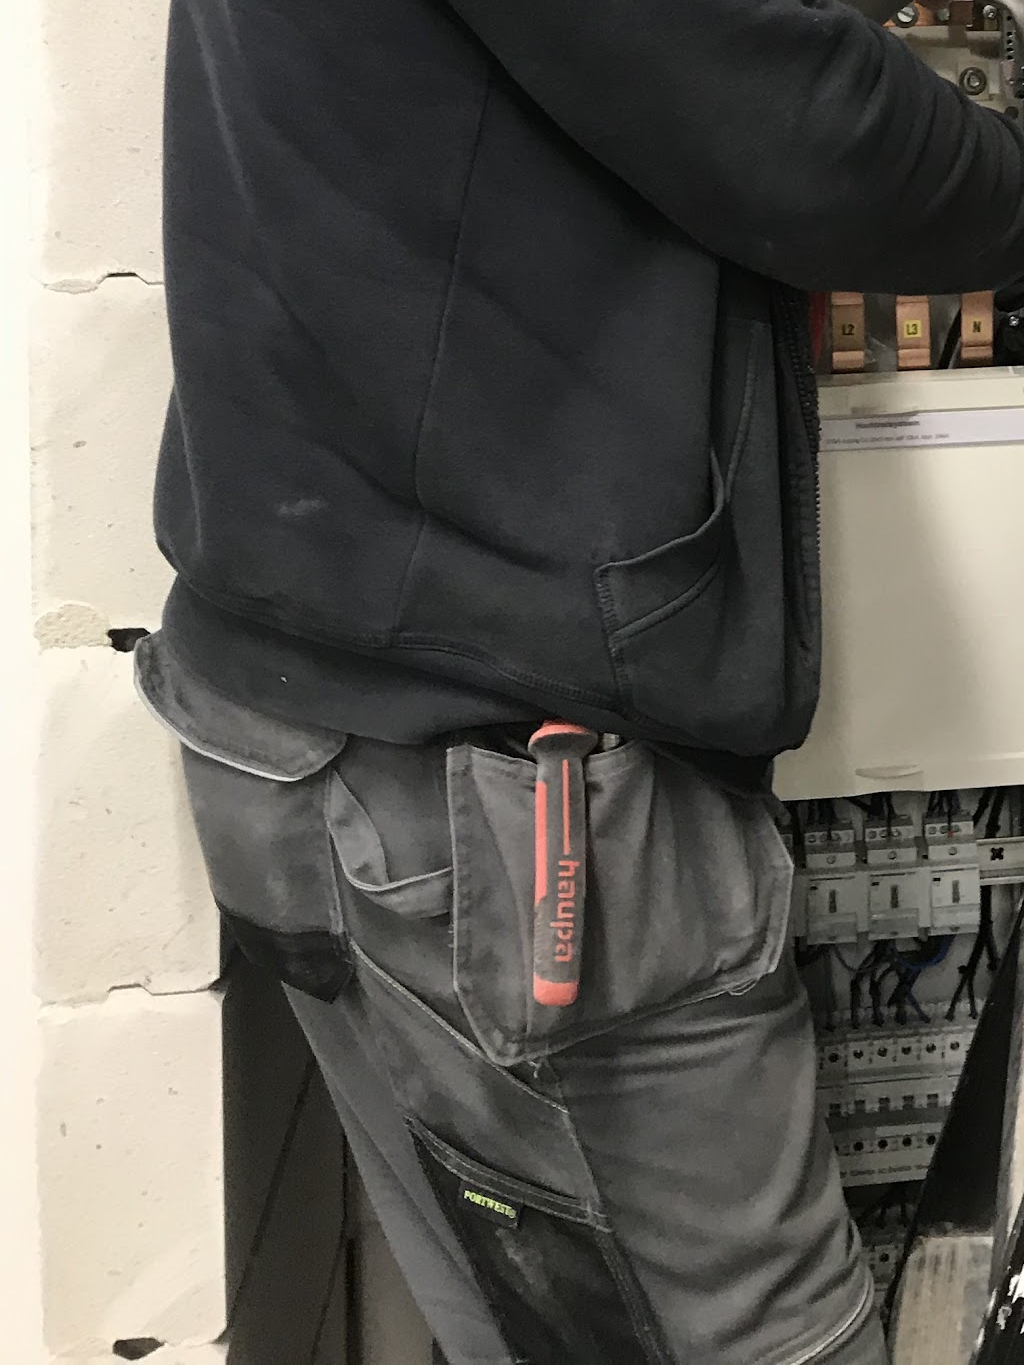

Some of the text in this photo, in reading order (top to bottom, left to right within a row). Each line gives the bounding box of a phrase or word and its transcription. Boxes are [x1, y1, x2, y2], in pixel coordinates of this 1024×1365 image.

[842, 324, 855, 336] L2
[906, 324, 919, 335] L3
[550, 860, 580, 963] haupa
